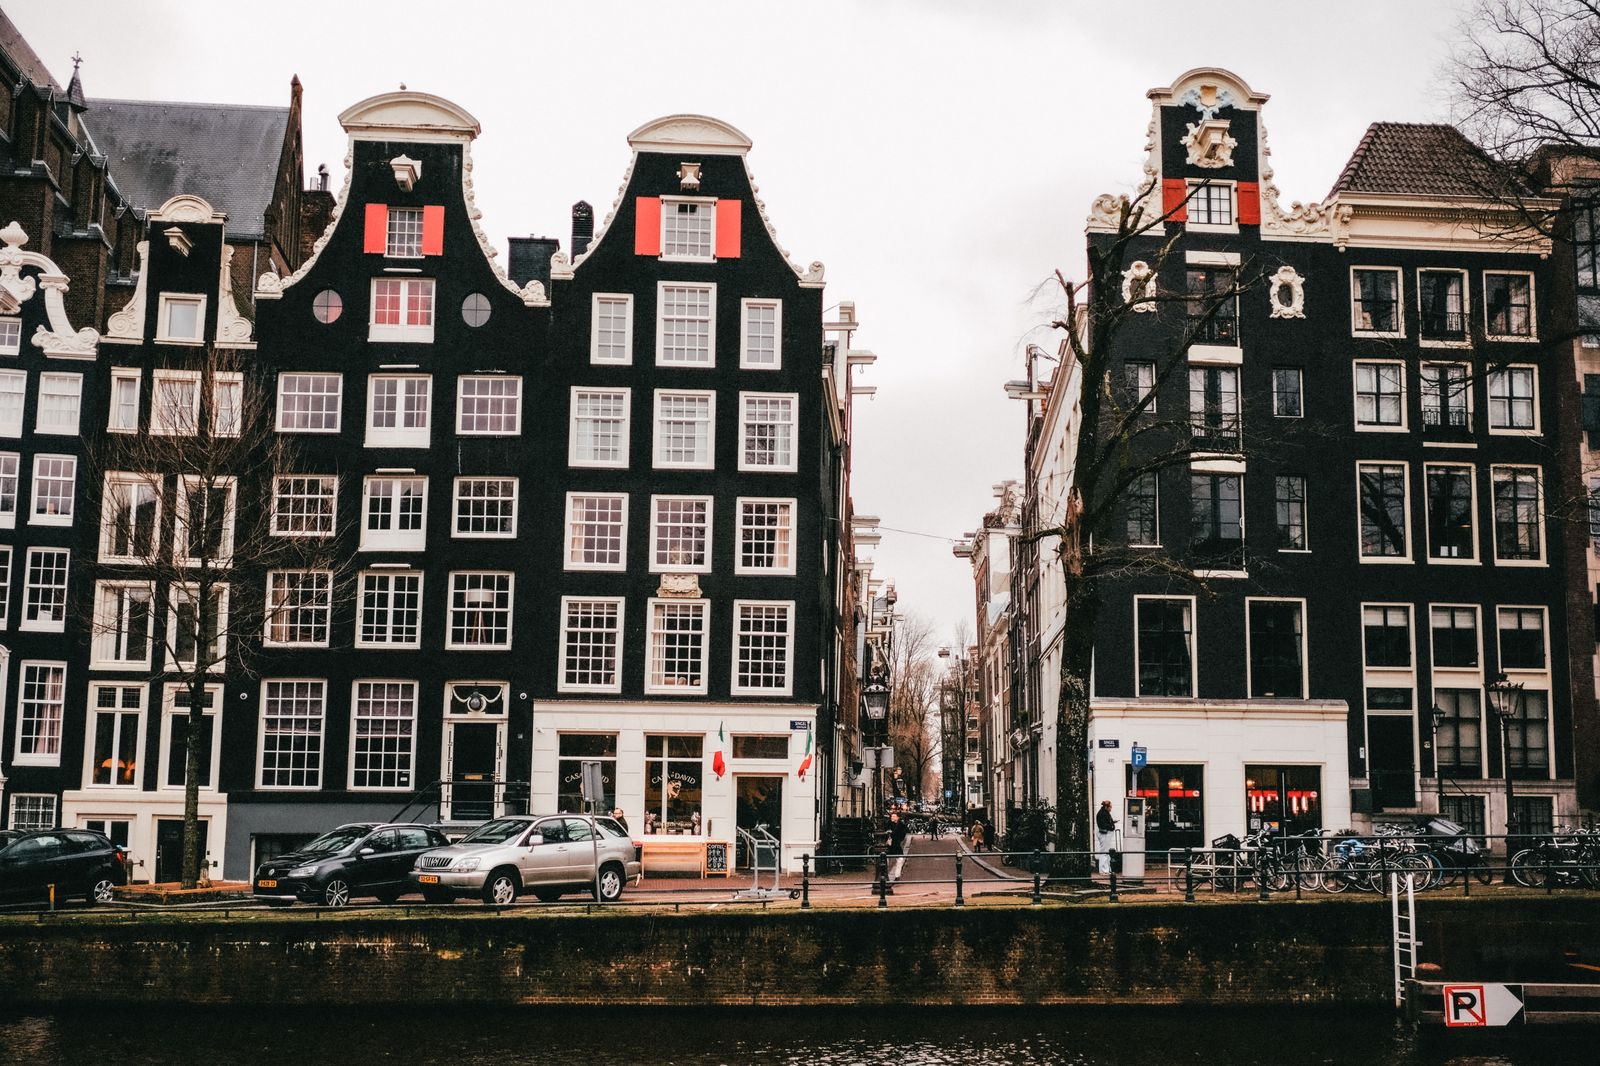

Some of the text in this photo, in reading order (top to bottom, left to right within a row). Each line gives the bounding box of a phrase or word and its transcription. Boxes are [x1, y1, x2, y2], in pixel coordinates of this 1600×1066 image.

[1135, 754, 1143, 765] P
[674, 772, 696, 785] DAVID
[1453, 992, 1477, 1020] P
